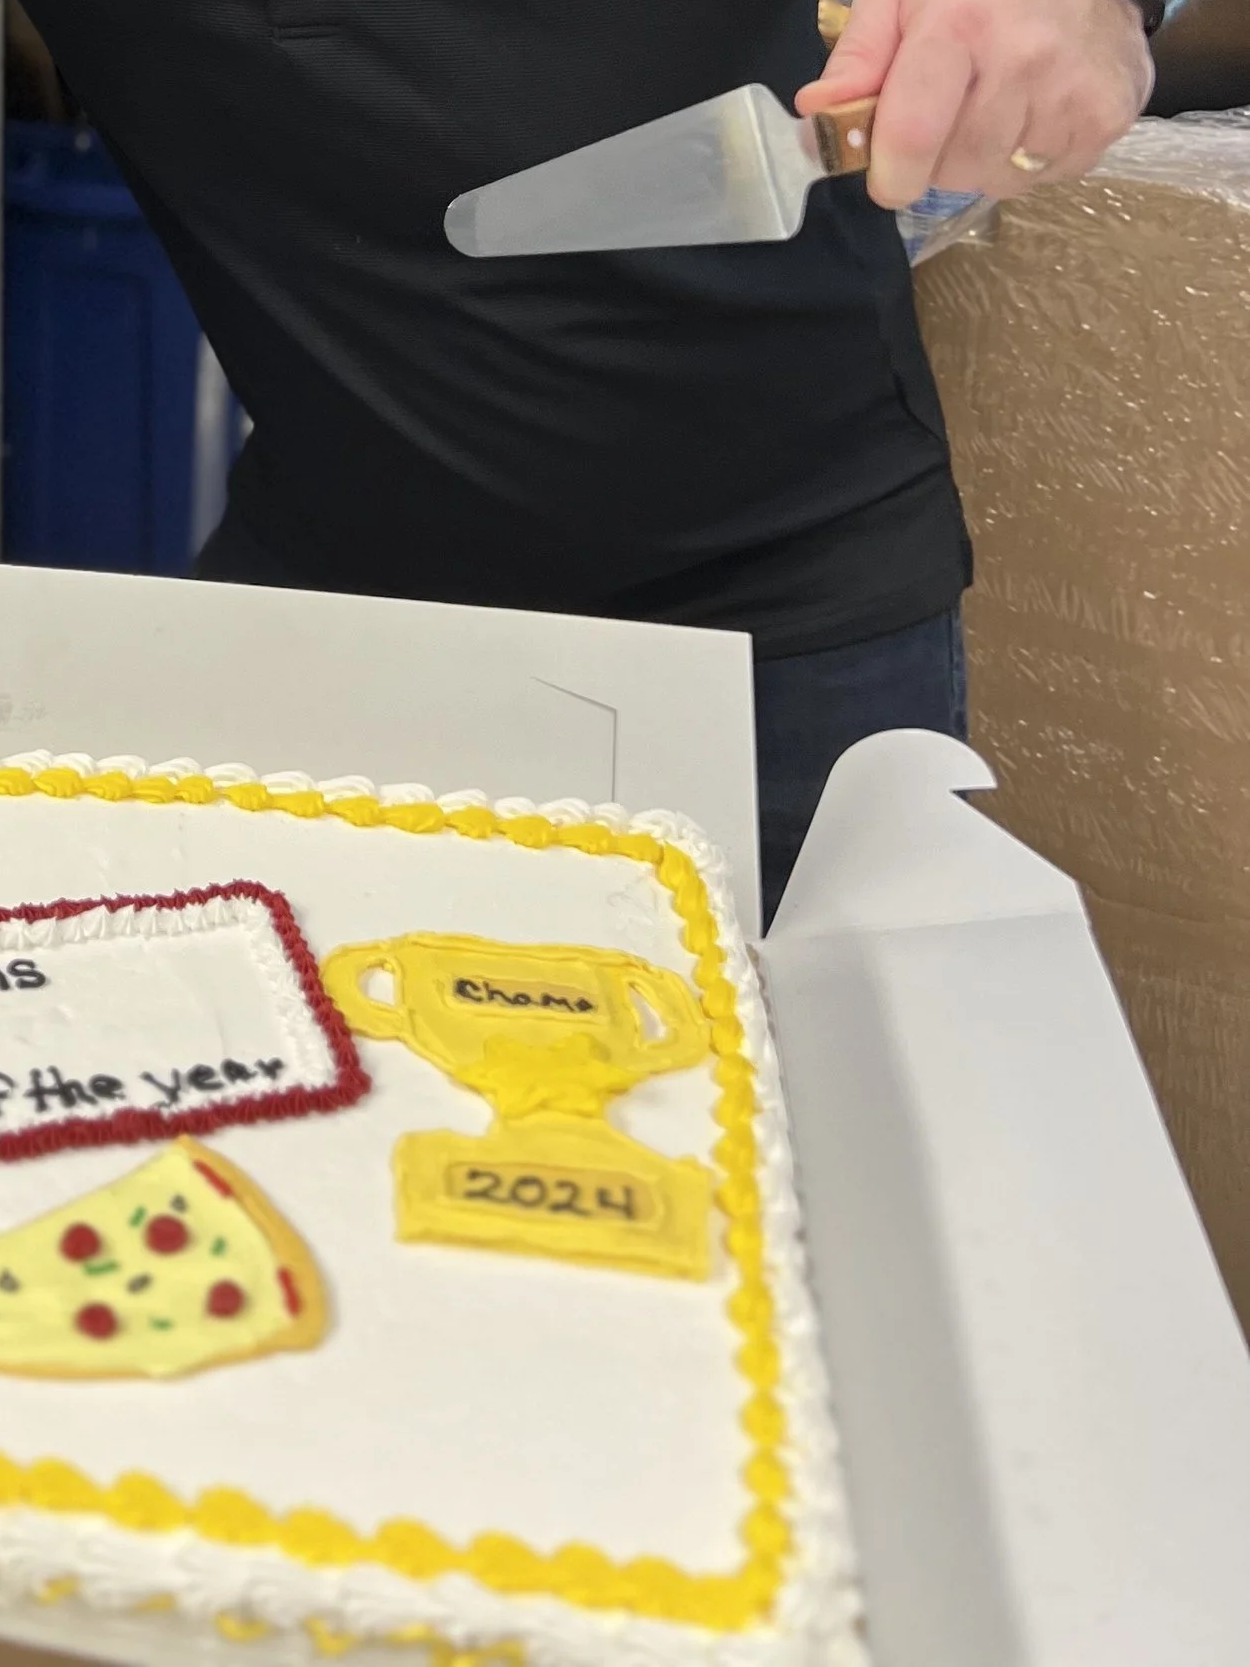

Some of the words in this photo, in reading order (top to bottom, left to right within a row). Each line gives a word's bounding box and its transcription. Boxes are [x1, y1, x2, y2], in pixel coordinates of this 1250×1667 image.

[25, 1065, 126, 1113] the
[139, 1055, 285, 1110] year
[461, 1168, 636, 1220] 2024
